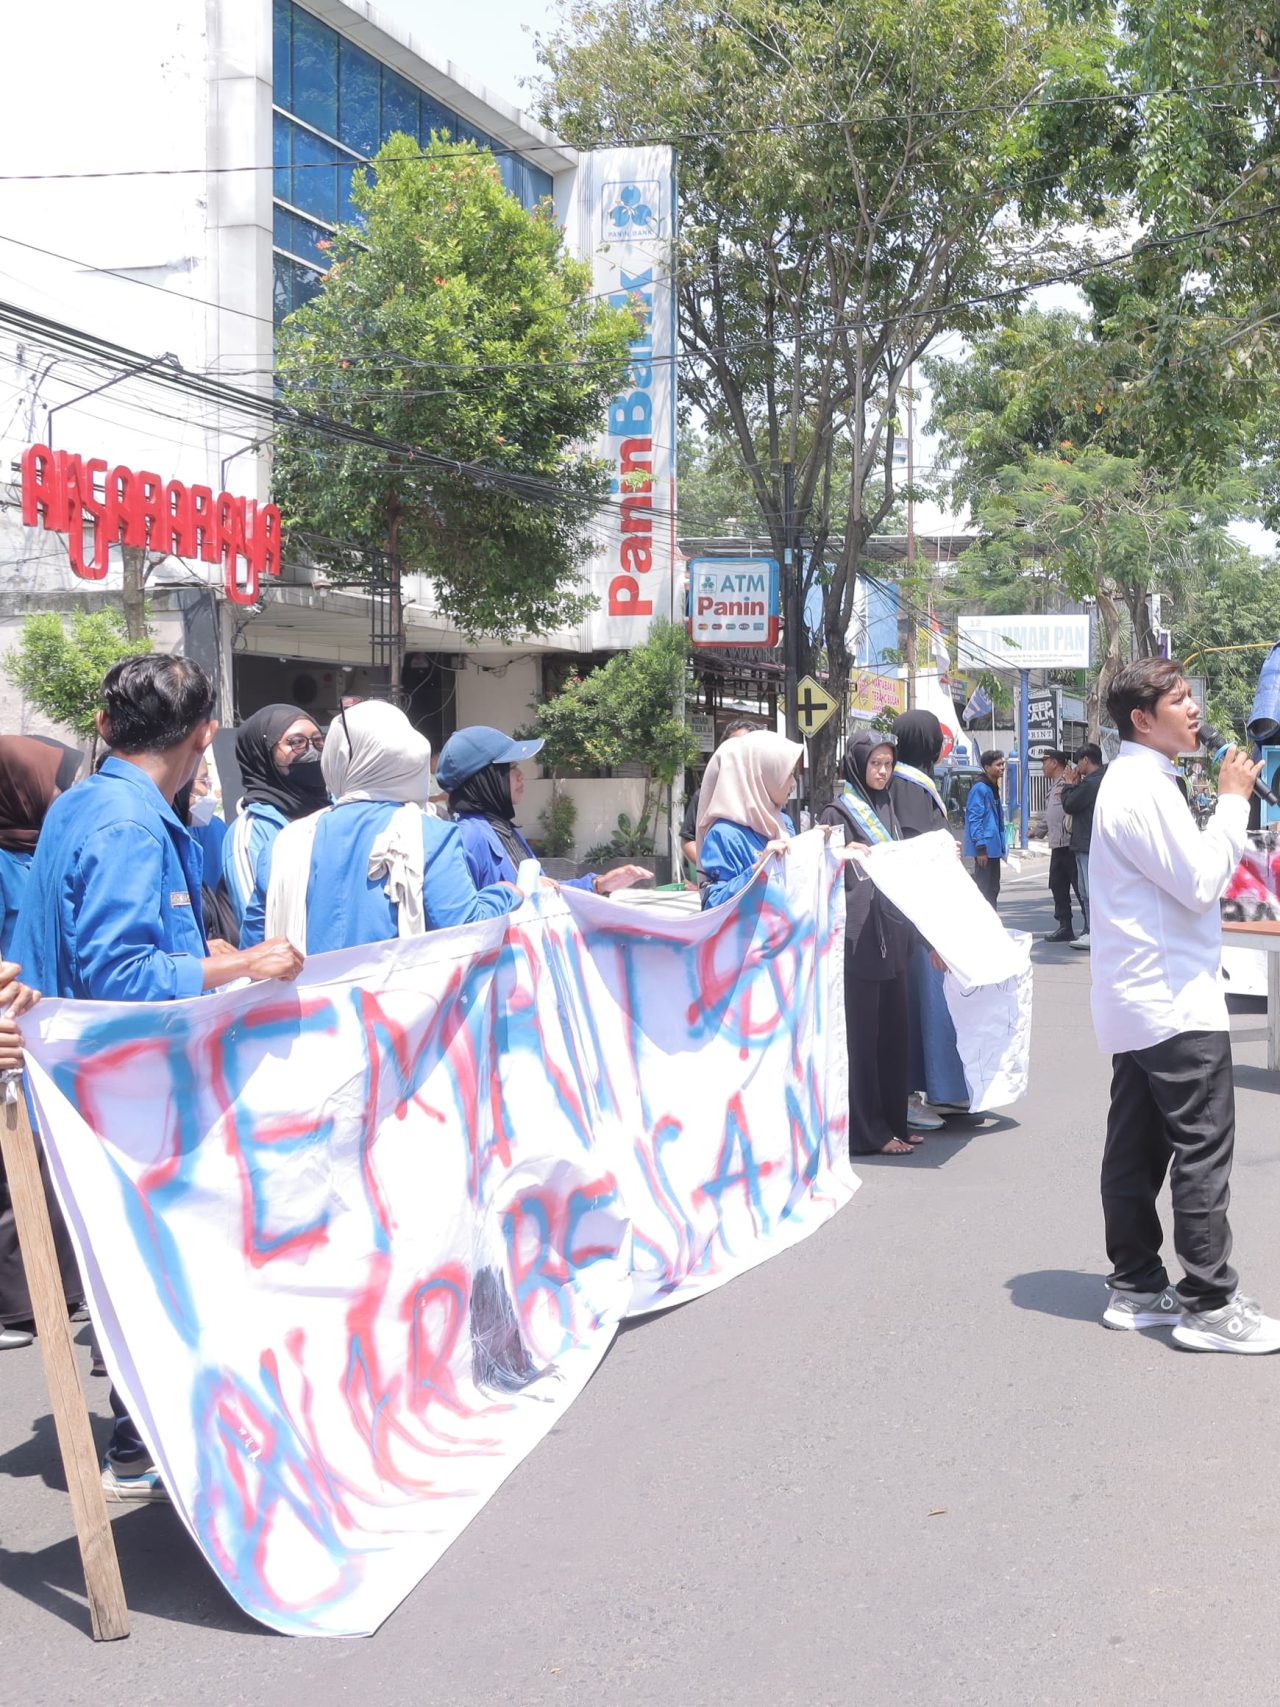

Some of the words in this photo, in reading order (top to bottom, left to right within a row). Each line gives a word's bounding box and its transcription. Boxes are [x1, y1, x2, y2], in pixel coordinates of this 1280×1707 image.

[720, 574, 765, 593] ATM
[697, 596, 765, 616] Panin
[991, 626, 1050, 652] RUMAH
[1053, 625, 1085, 651] PAN
[1027, 709, 1055, 723] ALM
[1028, 731, 1053, 739] RINT
